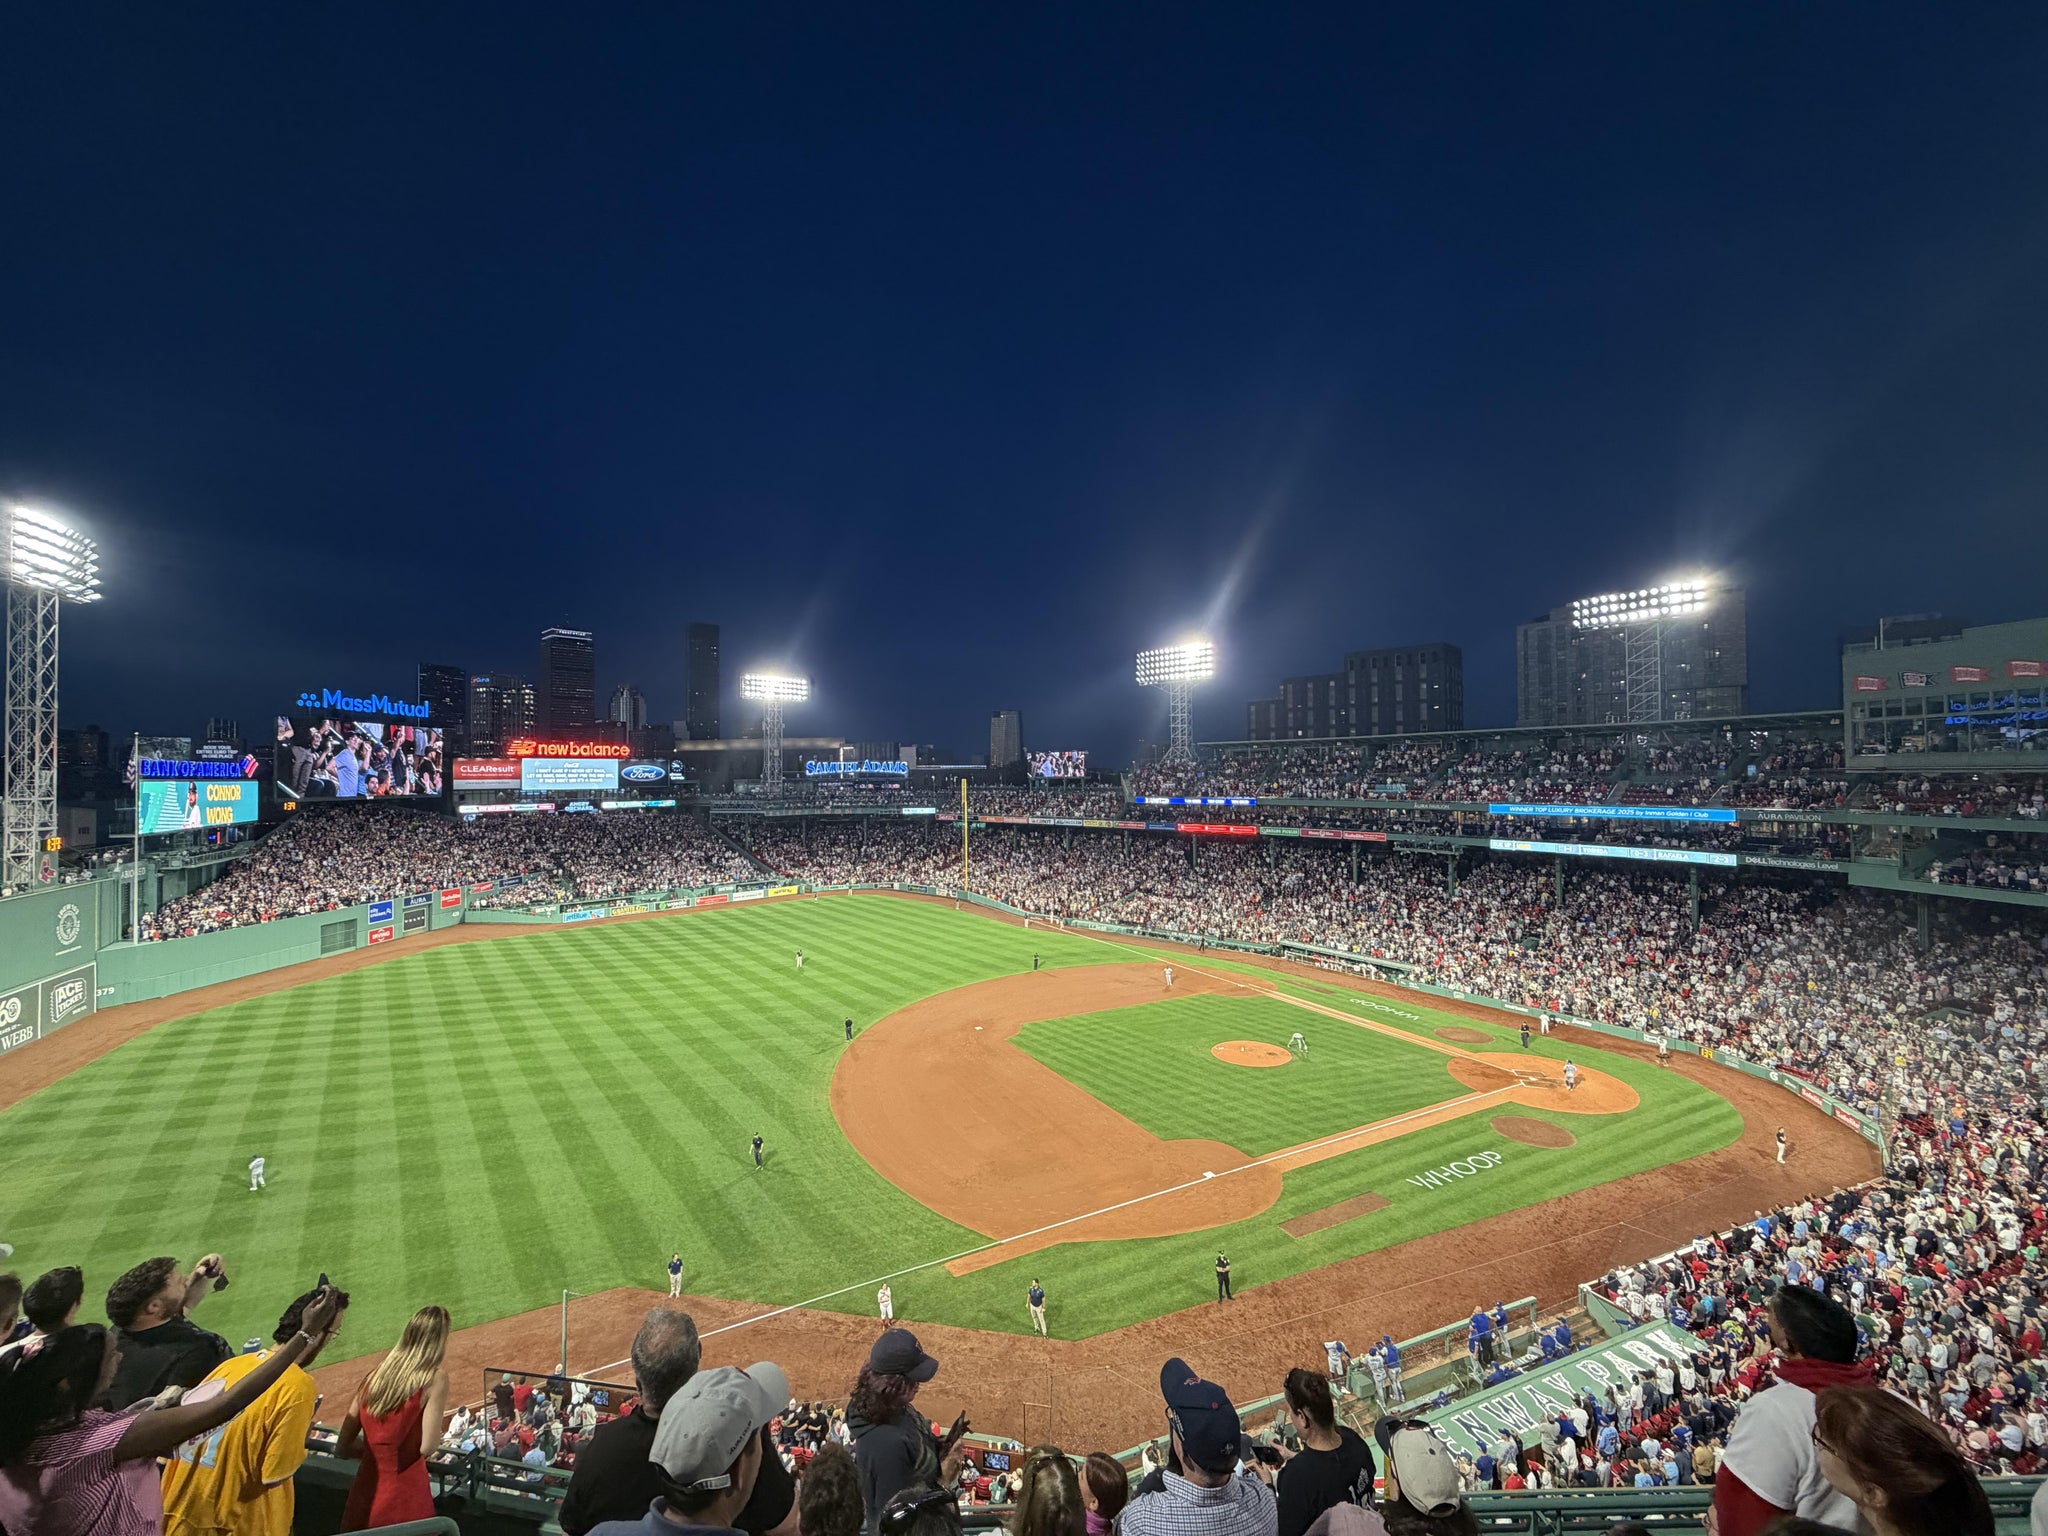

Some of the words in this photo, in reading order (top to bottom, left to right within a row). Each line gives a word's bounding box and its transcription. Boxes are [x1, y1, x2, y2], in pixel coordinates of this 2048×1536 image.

[323, 688, 430, 718] MassMutual
[140, 759, 179, 777] BANK
[180, 760, 196, 777] OF
[196, 761, 242, 778] AMERICA
[460, 765, 515, 773] CLEAResult
[629, 767, 657, 779] Ford
[806, 760, 861, 776] SAMUEL
[861, 759, 909, 775] ADAMS
[207, 784, 241, 801] CONNOR
[206, 807, 233, 824] WONG
[1784, 813, 1822, 821] PAVILION
[1658, 852, 1689, 860] RAFAELA
[1745, 856, 1768, 864] DELL
[1768, 858, 1816, 869] Technologies
[1817, 861, 1839, 870] Level
[565, 911, 588, 920] jetBlue
[57, 981, 84, 1003] ACE
[97, 987, 114, 997] 379
[58, 992, 84, 1013] TICKET
[0, 1026, 33, 1050] WEBB
[1405, 1151, 1502, 1190] WHOOP
[1429, 1372, 1584, 1464] ENWAY
[1576, 1329, 1698, 1391] PARK
